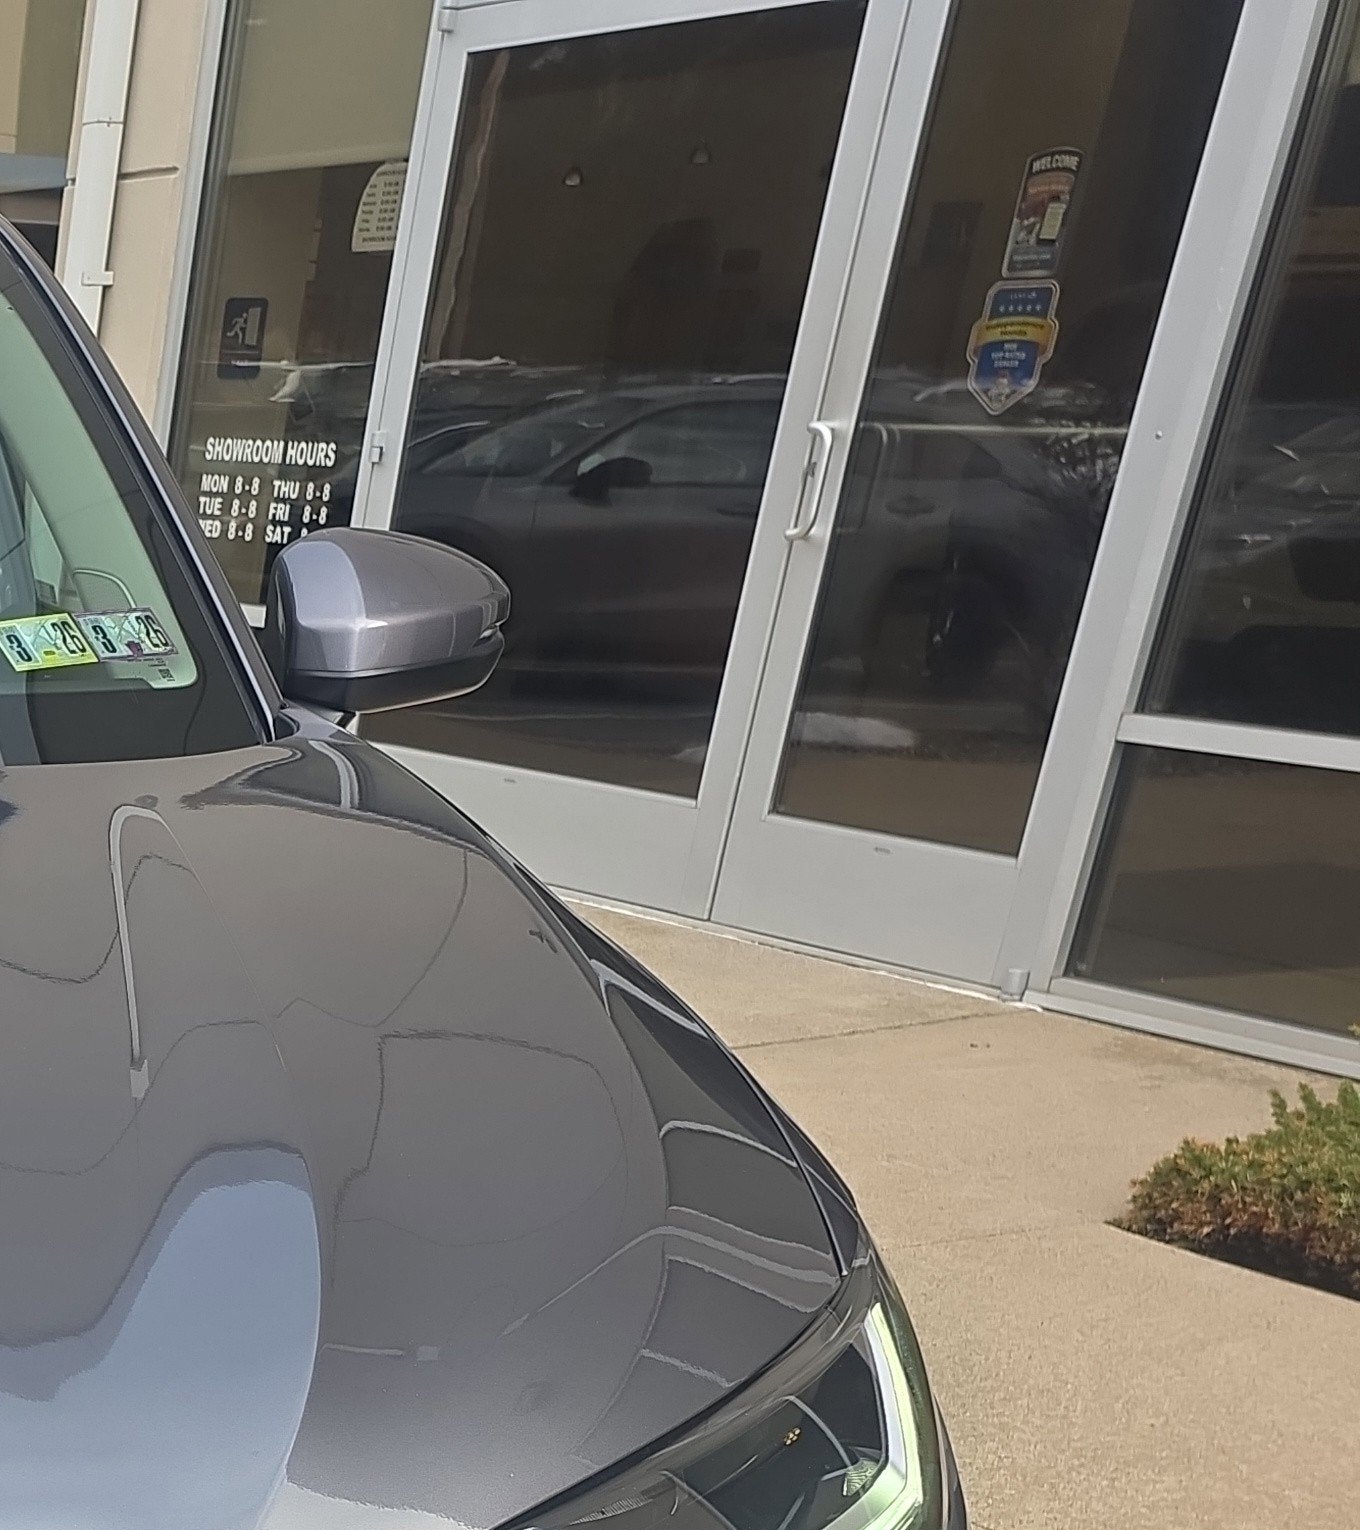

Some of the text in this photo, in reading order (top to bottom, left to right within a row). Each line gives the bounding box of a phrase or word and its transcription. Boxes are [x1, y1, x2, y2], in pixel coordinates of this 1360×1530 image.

[204, 436, 337, 467] SHOWROOM HOURS
[200, 473, 230, 494] MON
[272, 479, 300, 500] THU
[198, 496, 223, 516] TUE
[268, 502, 291, 522] FRI
[264, 524, 292, 545] SAT
[5, 620, 88, 663] 3 26
[91, 614, 169, 655] 3 26
